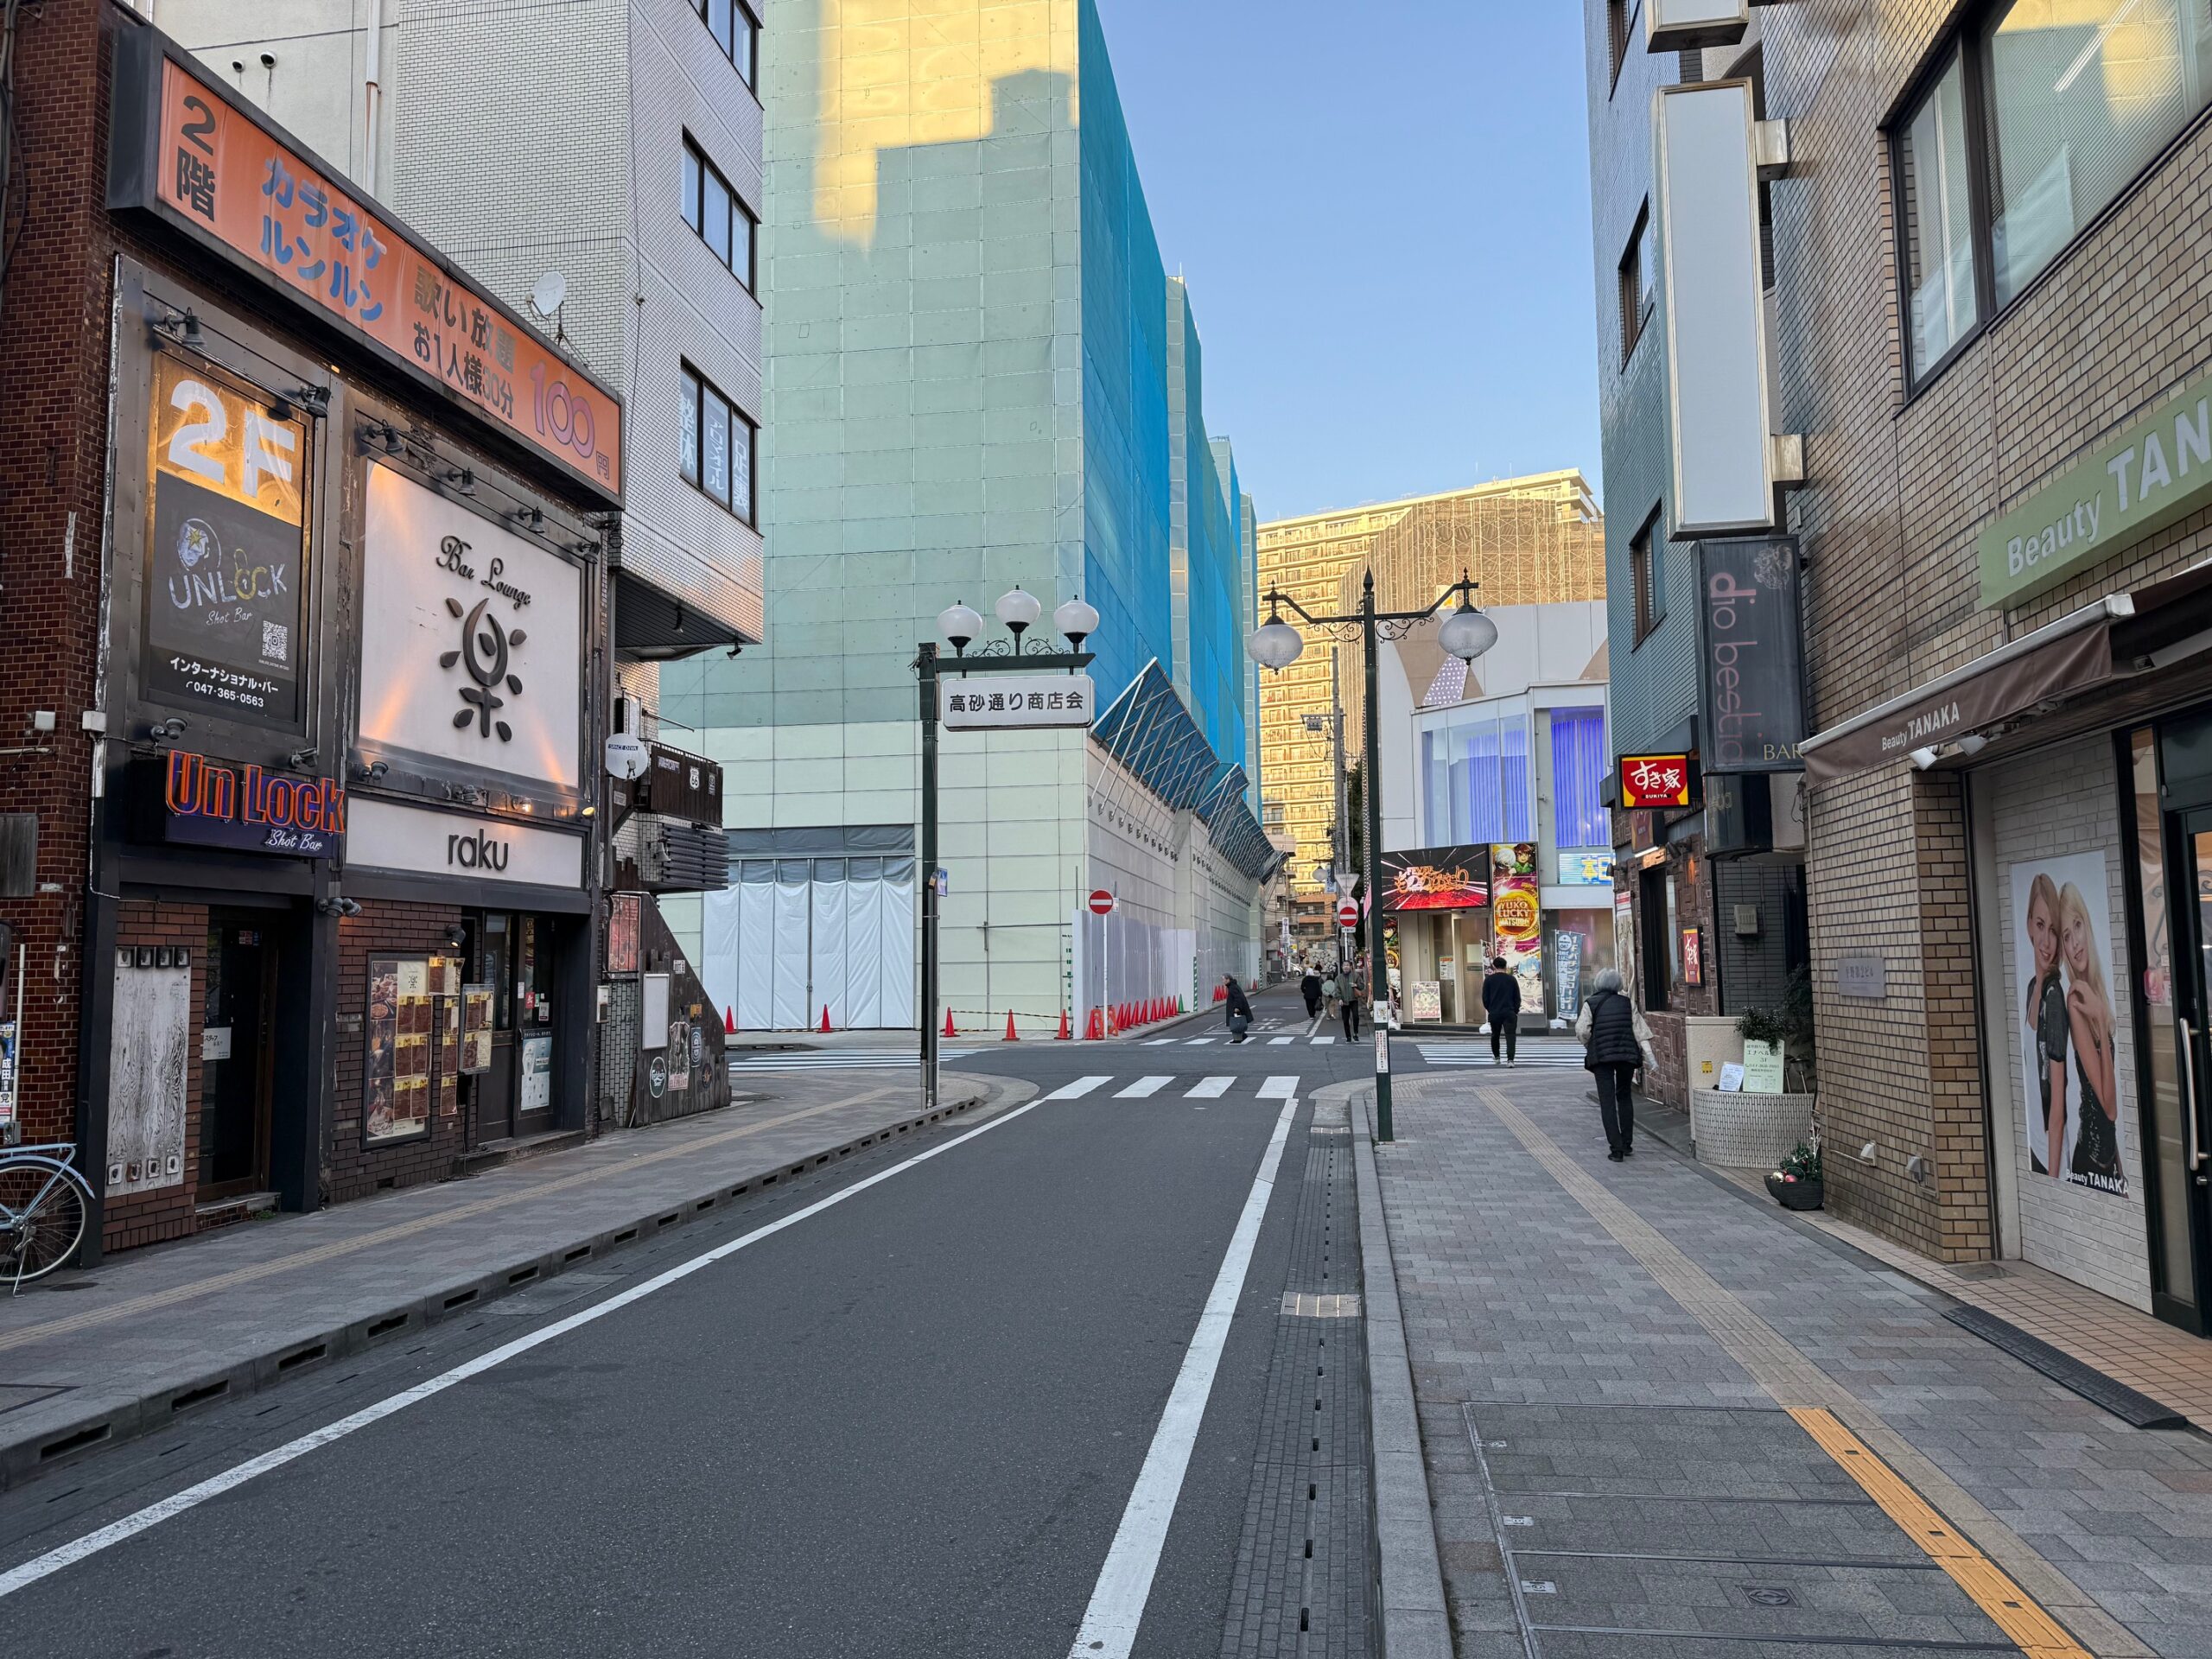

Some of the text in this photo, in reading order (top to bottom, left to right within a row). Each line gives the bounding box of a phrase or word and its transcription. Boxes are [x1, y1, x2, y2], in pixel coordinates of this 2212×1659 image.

[177, 95, 216, 222] 2階
[262, 158, 386, 270] カラオケ
[260, 215, 383, 321] ルンルン
[168, 380, 295, 498] 2F
[2005, 490, 2101, 578] Beauty
[168, 563, 287, 609] UNLOCK
[435, 535, 531, 609] Bar Lounge
[206, 607, 253, 626] Shot Bar
[1709, 572, 1757, 630] dio
[950, 690, 1084, 713] 高砂通り商店会
[1882, 701, 1960, 752] Beauty TANAKA
[1764, 743, 1804, 760] BAR
[165, 749, 344, 834] Un Lock
[691, 776, 698, 786] 66
[1630, 760, 1681, 792] すき家
[267, 828, 323, 851] Shot Bar
[448, 828, 508, 871] raku
[2066, 1168, 2129, 1195] Beauty TANAKA
